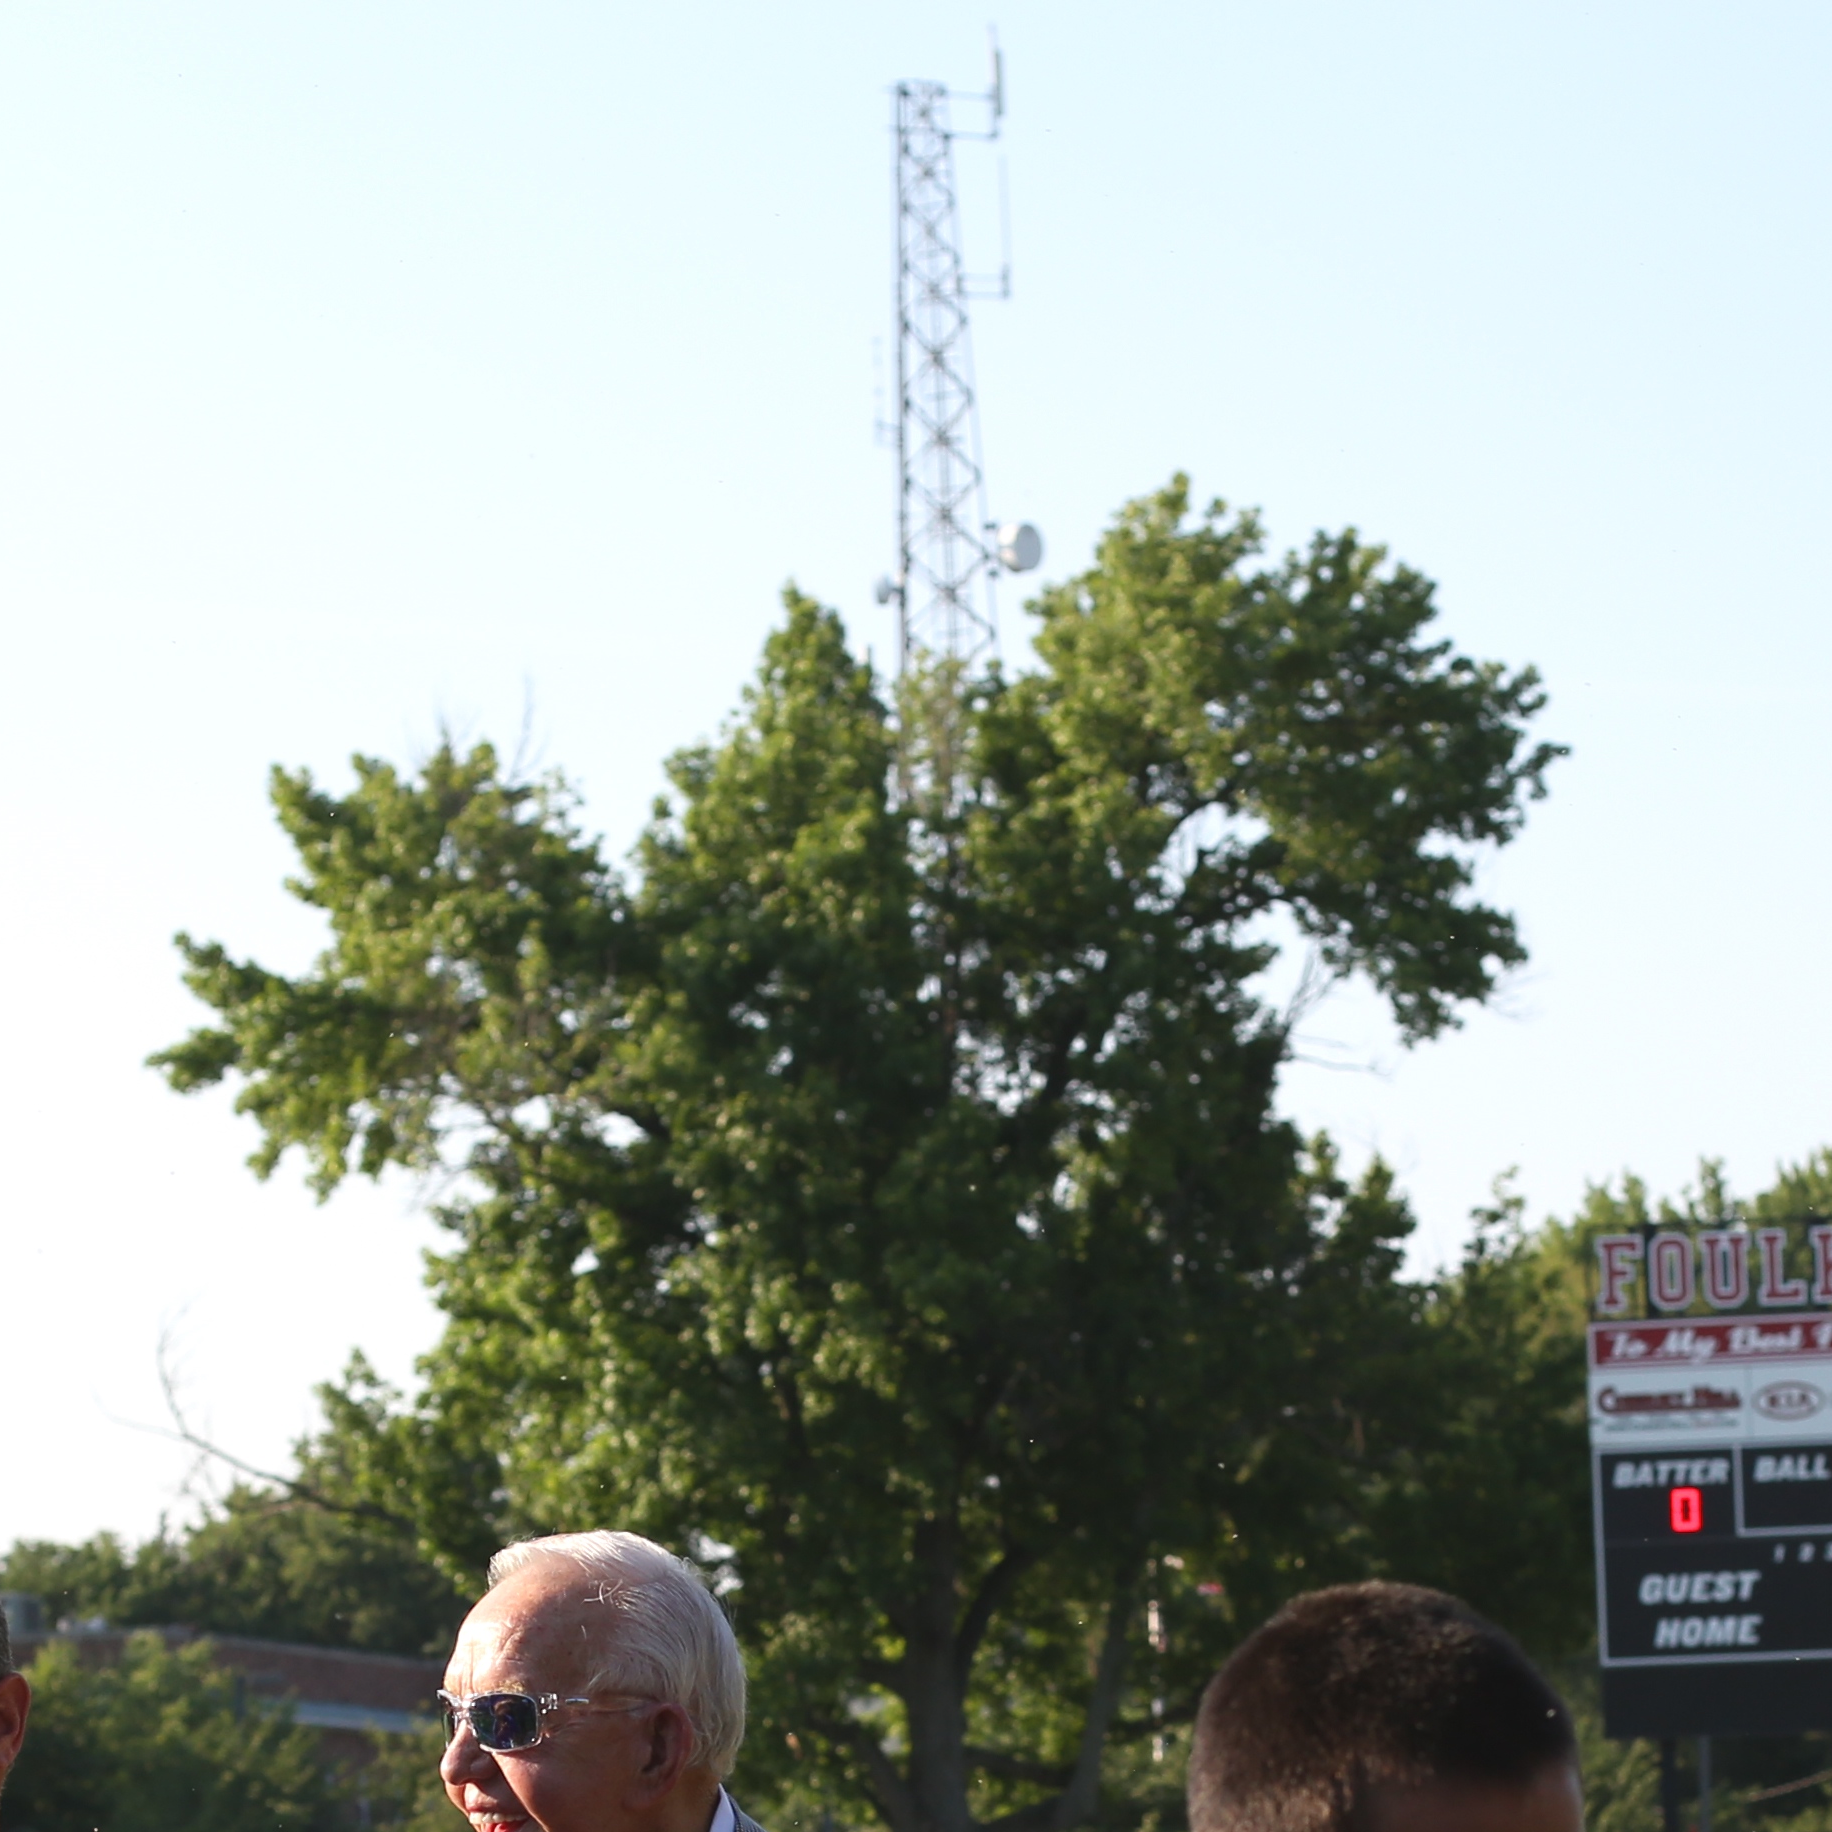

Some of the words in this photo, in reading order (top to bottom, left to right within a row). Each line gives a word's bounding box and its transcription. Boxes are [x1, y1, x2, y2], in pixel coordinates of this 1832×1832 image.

[1609, 1333, 1647, 1357] To
[1654, 1327, 1715, 1363] My
[1613, 1457, 1730, 1488] BATTER
[1754, 1453, 1832, 1482] BALL
[1670, 1486, 1703, 1533] 0
[1773, 1543, 1785, 1563] 1
[1798, 1542, 1815, 1562] 2
[1639, 1569, 1762, 1605] GUEST
[1654, 1614, 1763, 1649] HOME
